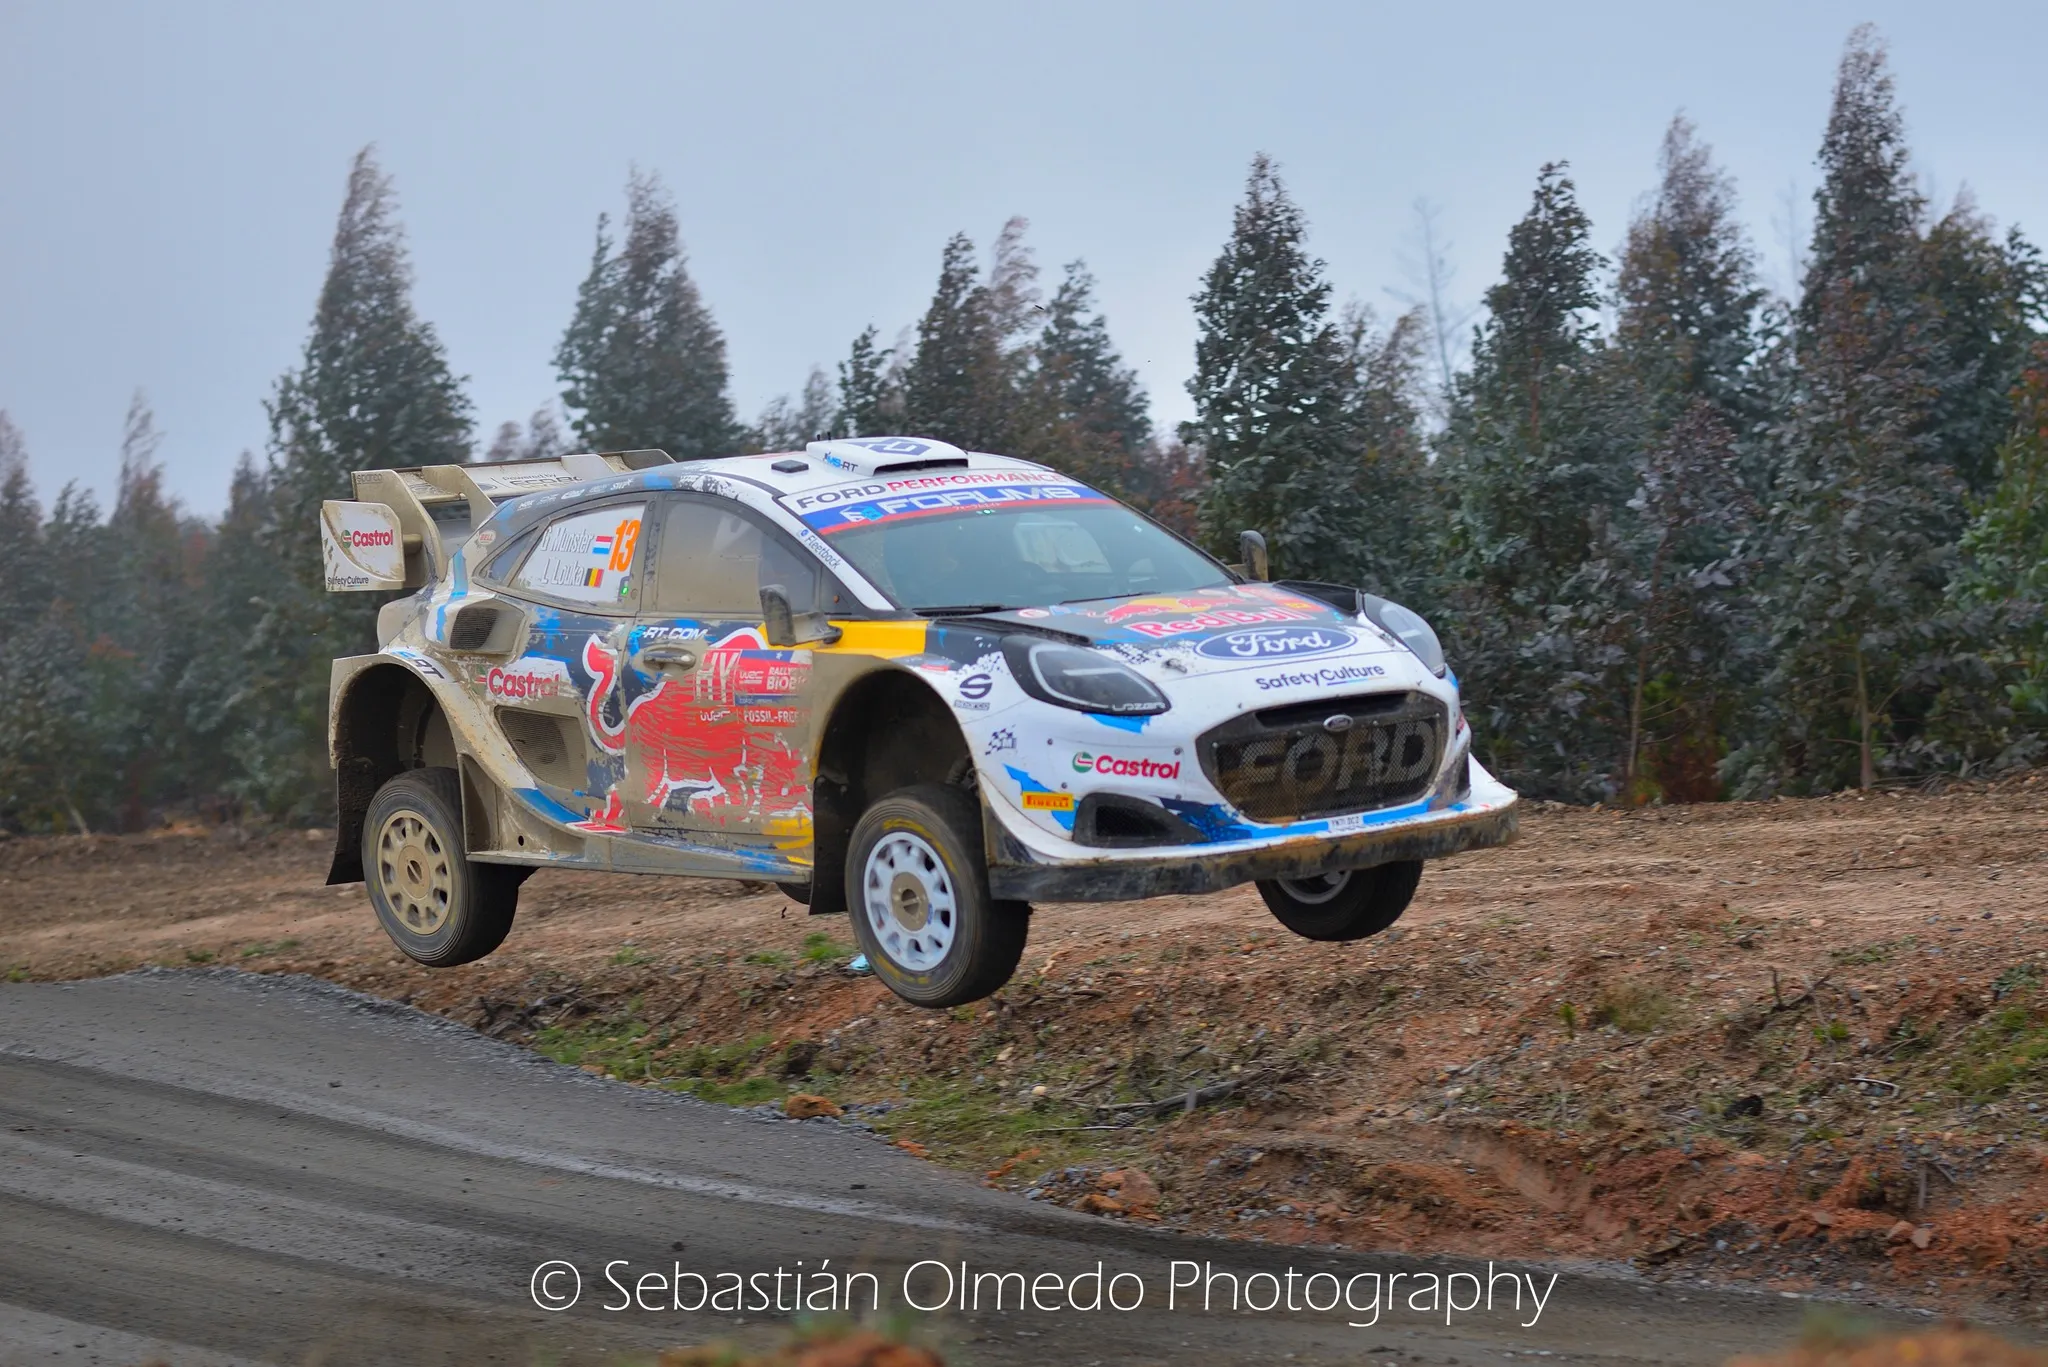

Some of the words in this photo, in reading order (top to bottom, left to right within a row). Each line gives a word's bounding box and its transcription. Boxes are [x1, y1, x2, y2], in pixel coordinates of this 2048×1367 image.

[796, 485, 886, 509] FORD
[886, 472, 1067, 492] PERFORMANCE
[877, 487, 1080, 514] FORUM8
[352, 529, 394, 547] Castrol
[480, 533, 494, 541] BELL
[608, 519, 641, 572] 13
[327, 576, 370, 587] SafetyCulture
[551, 558, 586, 587] Louka
[1124, 612, 1236, 638] Red
[1215, 606, 1316, 626] Bull
[1226, 629, 1332, 656] Ford
[488, 667, 560, 697] Castrol
[1256, 662, 1385, 690] SafetyCulture
[1095, 755, 1180, 780] Castrol
[1238, 721, 1437, 796] FORD
[1026, 794, 1070, 808] PIRELLI
